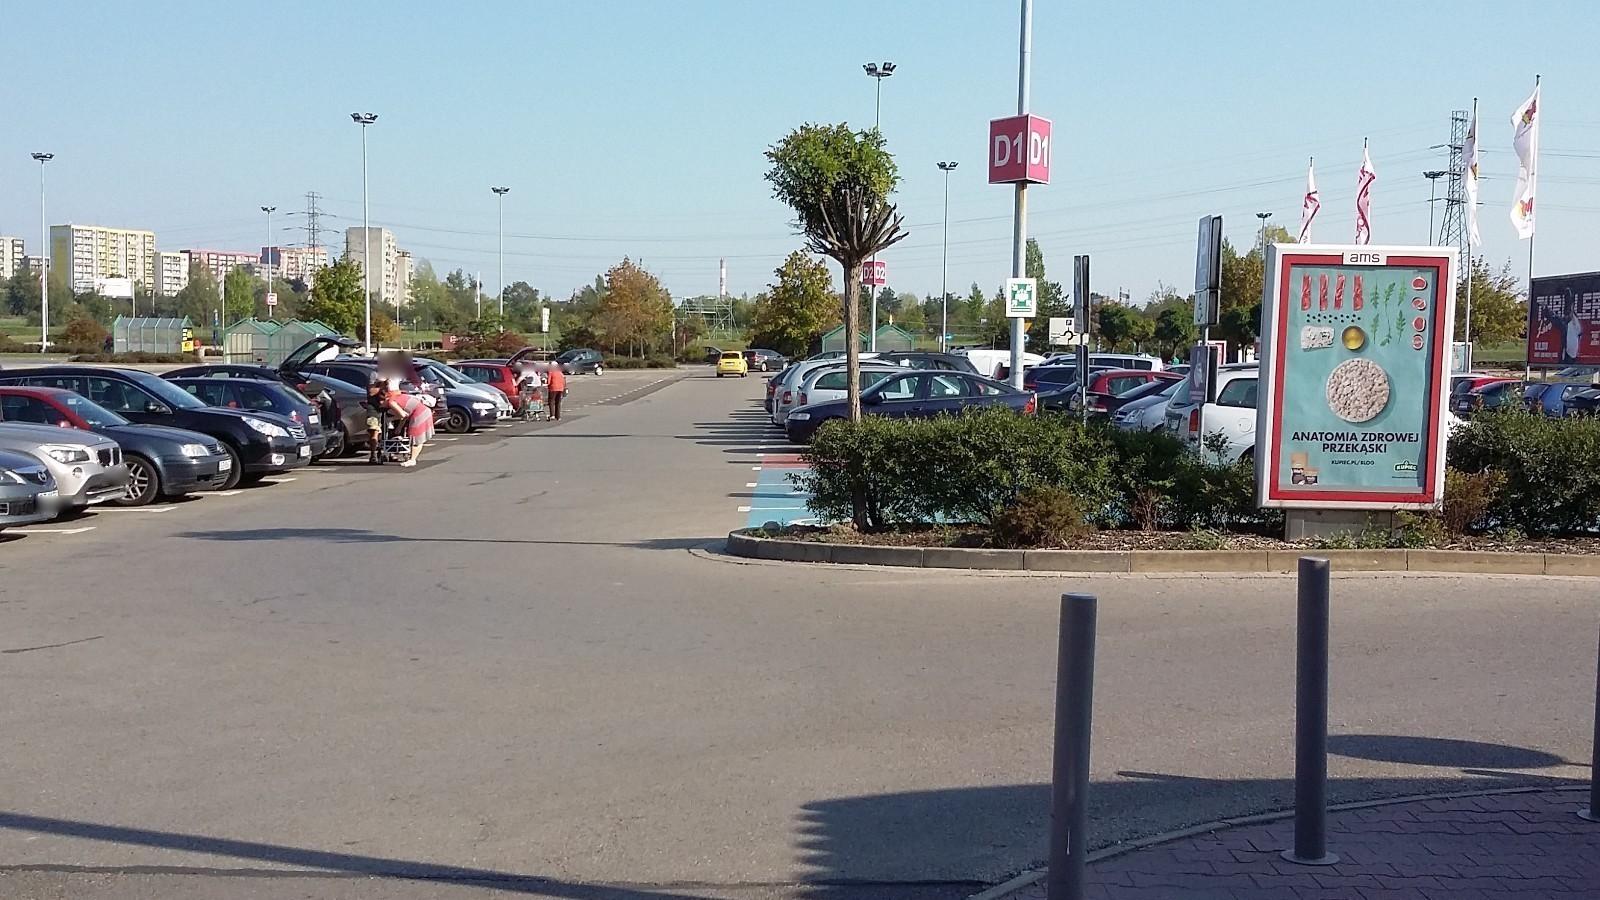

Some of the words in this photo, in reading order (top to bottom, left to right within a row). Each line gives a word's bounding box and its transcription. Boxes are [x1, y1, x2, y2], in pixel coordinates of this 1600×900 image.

[994, 132, 1023, 167] D1
[1031, 131, 1049, 168] D1
[1350, 253, 1380, 263] ams
[863, 266, 874, 279] D2
[875, 266, 886, 279] D2
[1292, 431, 1358, 442] ANATOMIA
[1360, 432, 1419, 443] ZDROWEJ
[1322, 443, 1387, 455] PRZEKĄSKI
